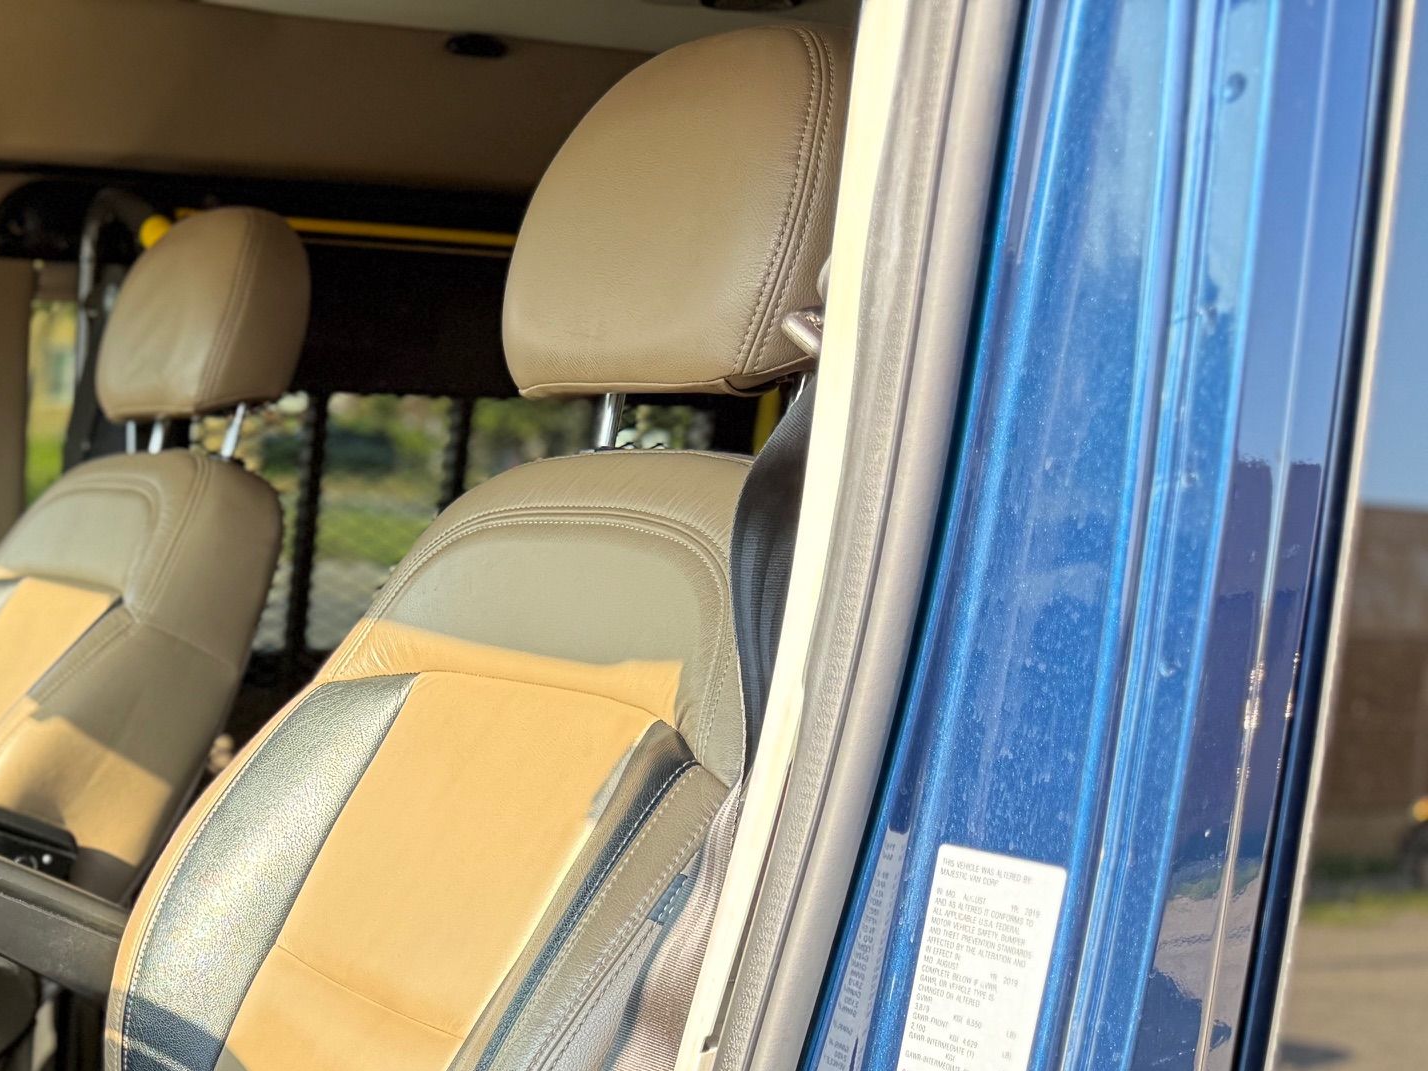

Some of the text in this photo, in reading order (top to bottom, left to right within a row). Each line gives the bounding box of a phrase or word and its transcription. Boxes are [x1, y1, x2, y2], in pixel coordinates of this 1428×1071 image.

[939, 867, 981, 883] MAJESTIC VAN
[955, 860, 979, 872] VEHICLE
[981, 866, 995, 876] WAS
[932, 906, 1020, 935] ALL APPLICABLE FEDERAL
[934, 897, 1034, 927] AND AS ALTERED IT CONFORMS TO
[928, 926, 1032, 959] AND THEFT PREVENTION STANDARDS
[930, 916, 951, 927] MOTOR
[952, 921, 975, 934] VEHICLE
[1000, 933, 1025, 946] BUMPER
[925, 945, 931, 953] IN
[932, 947, 952, 958] EFFECT
[926, 935, 954, 949] AFFECTED
[955, 943, 964, 951] BY
[965, 945, 976, 954] THE
[1012, 958, 1026, 968] AND
[920, 964, 950, 979] COMPLETE
[951, 972, 971, 984] BELOW
[936, 958, 1019, 988] AUGUST 2019
[917, 983, 980, 1007] CHANGED OR ALTERED
[938, 979, 947, 988] OR
[948, 982, 971, 995] VEHICLE
[972, 989, 986, 999] TYPE
